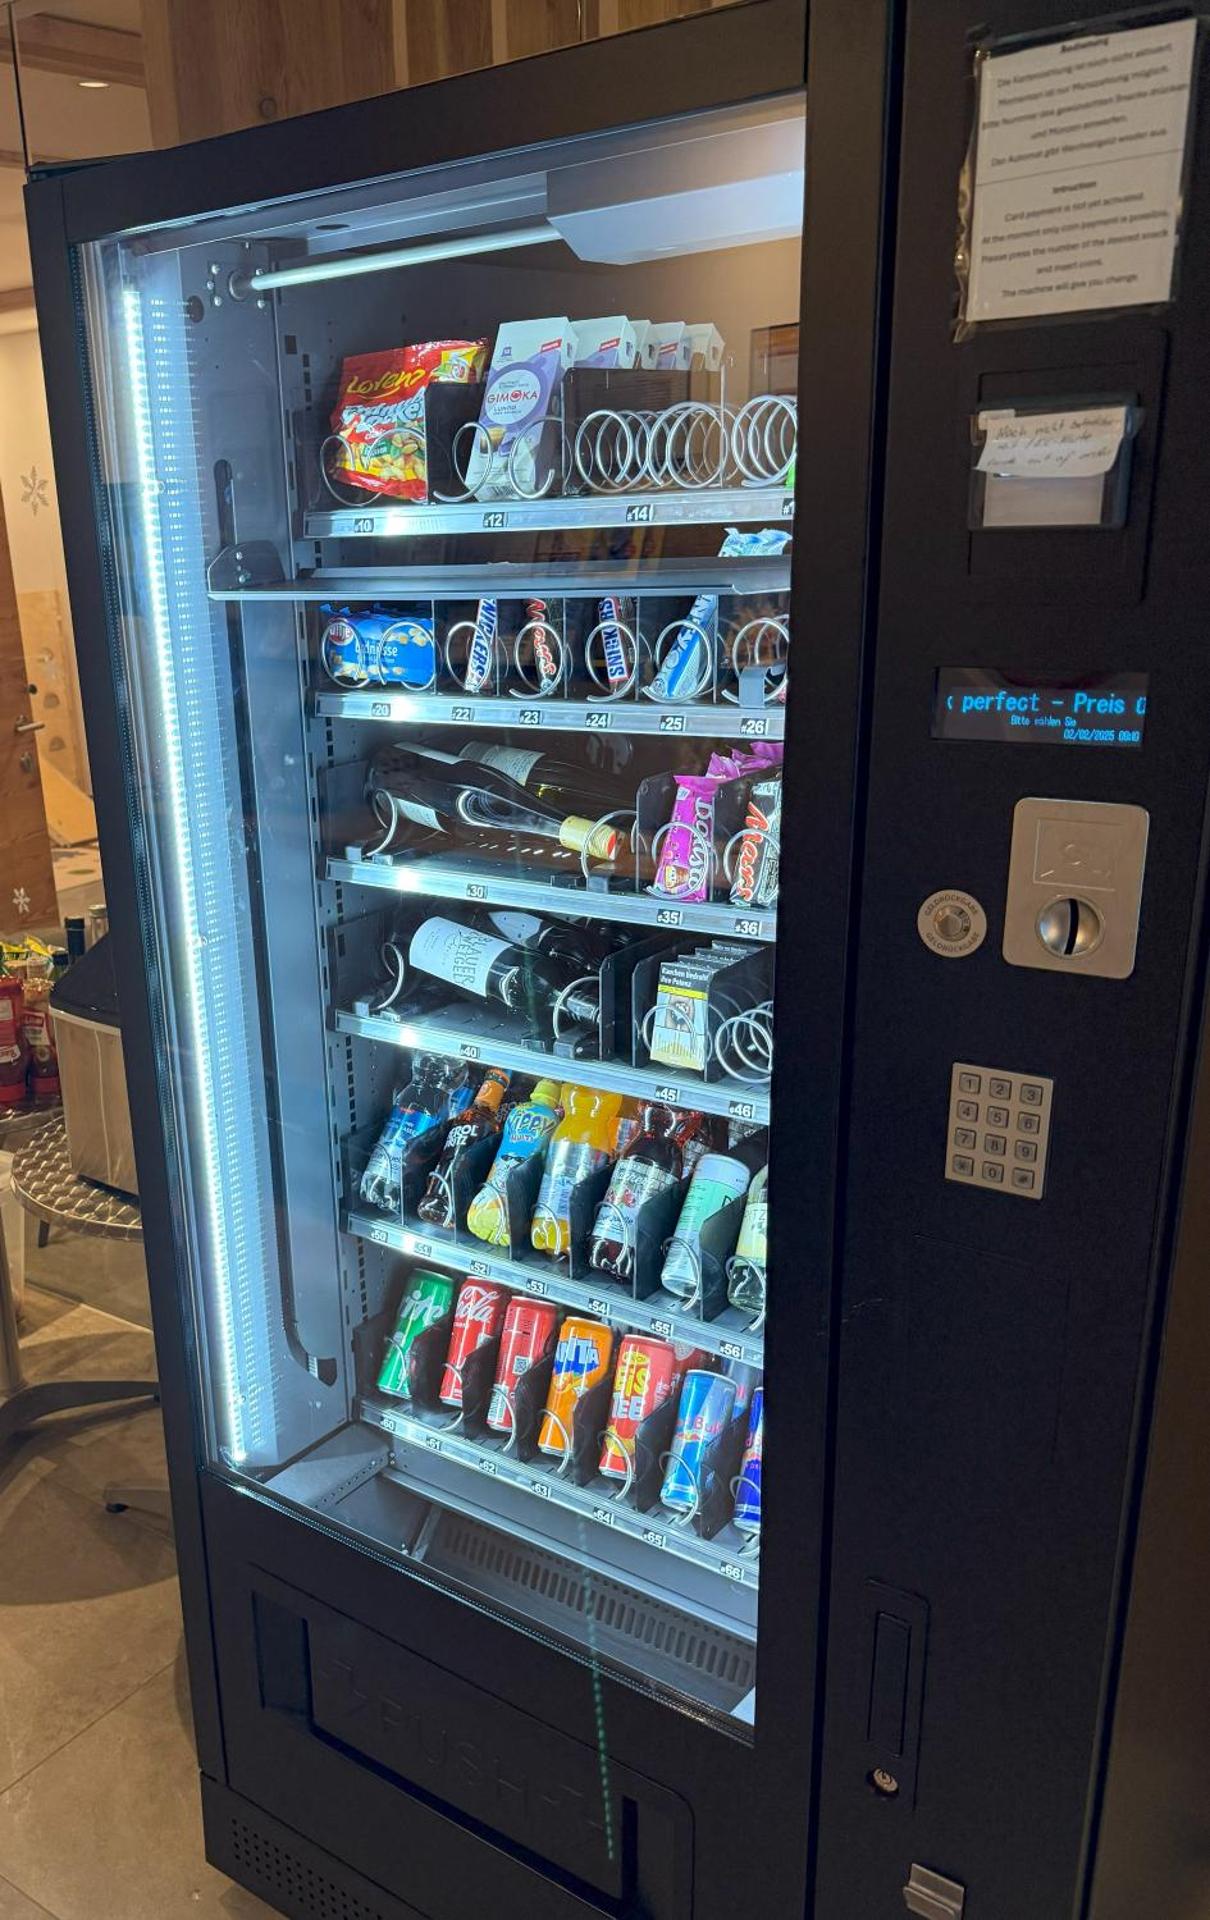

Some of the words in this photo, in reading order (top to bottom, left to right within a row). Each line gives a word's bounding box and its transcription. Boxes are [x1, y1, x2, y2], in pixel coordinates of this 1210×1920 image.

[346, 368, 426, 394] Lorenz
[487, 389, 538, 404] GIMOKA
[962, 689, 1040, 713] perfect
[1073, 692, 1125, 715] Preis
[736, 802, 769, 902] Mars
[995, 1083, 1004, 1096] 2
[1026, 1089, 1036, 1101] 3
[962, 1106, 971, 1118] 4
[993, 1110, 1001, 1123] 5
[1023, 1116, 1033, 1129] 6
[960, 1133, 968, 1144] 7
[990, 1137, 999, 1150] 8
[1021, 1145, 1031, 1157] 9
[988, 1167, 997, 1178] 0
